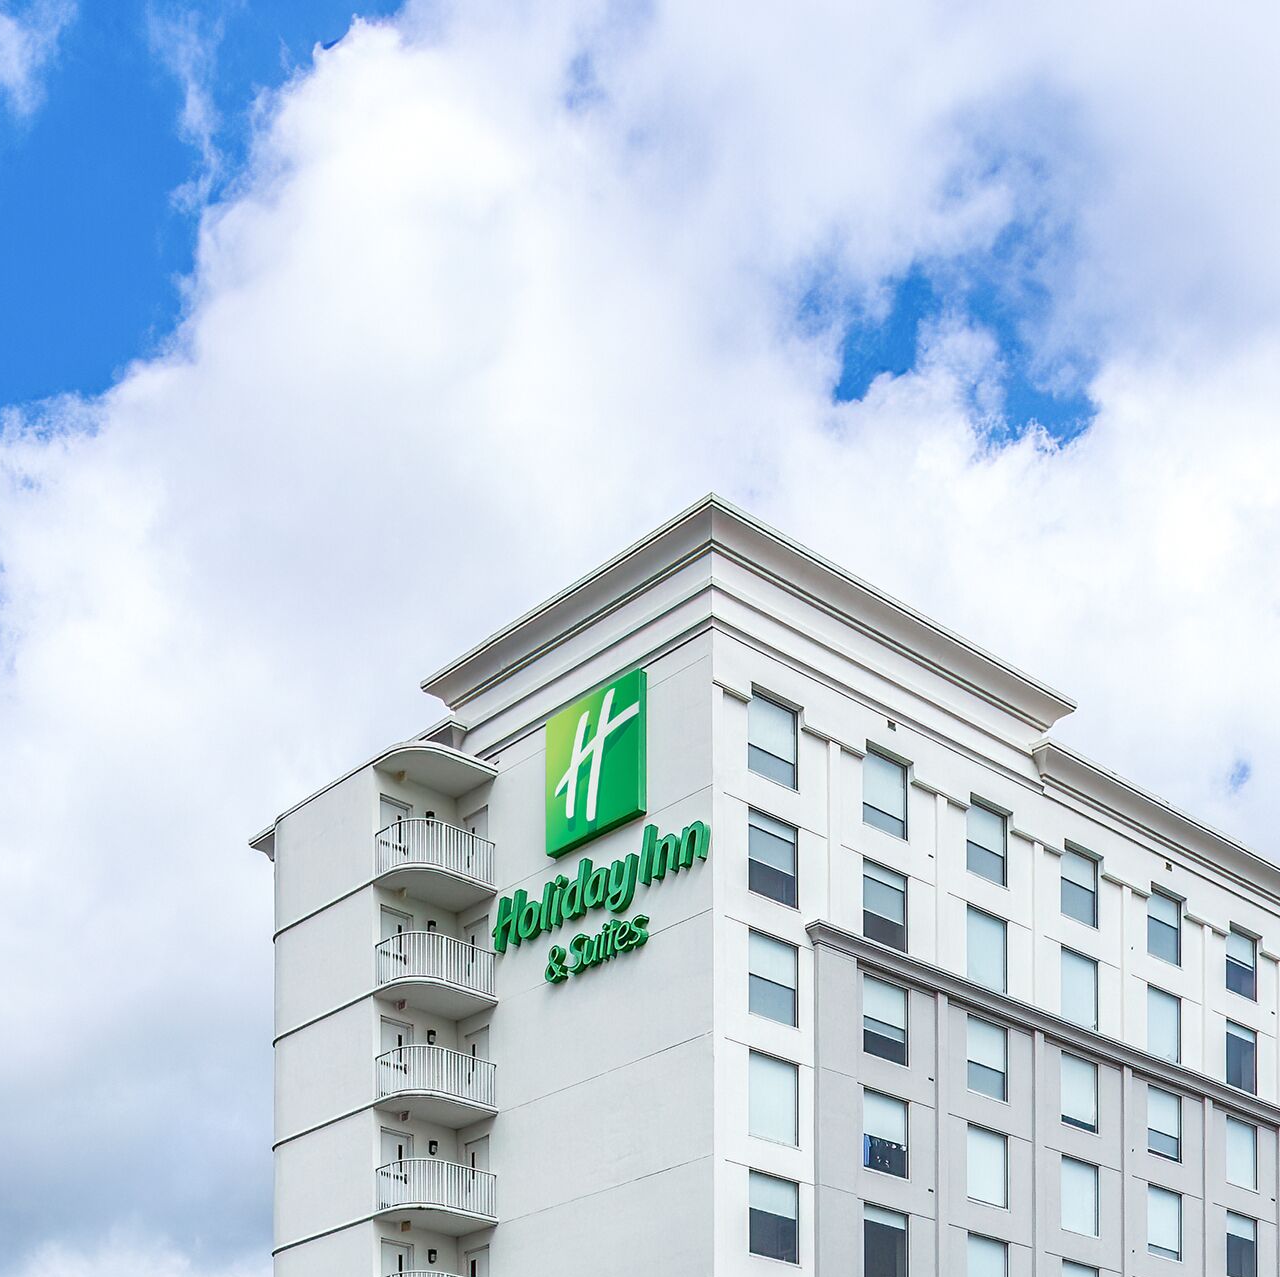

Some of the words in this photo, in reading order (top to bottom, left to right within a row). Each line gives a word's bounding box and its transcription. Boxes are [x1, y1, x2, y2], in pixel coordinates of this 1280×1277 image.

[554, 687, 640, 822] H
[492, 853, 640, 954] Holiday
[638, 820, 711, 887] Inn
[544, 945, 568, 985] &
[567, 914, 650, 976] Suites
